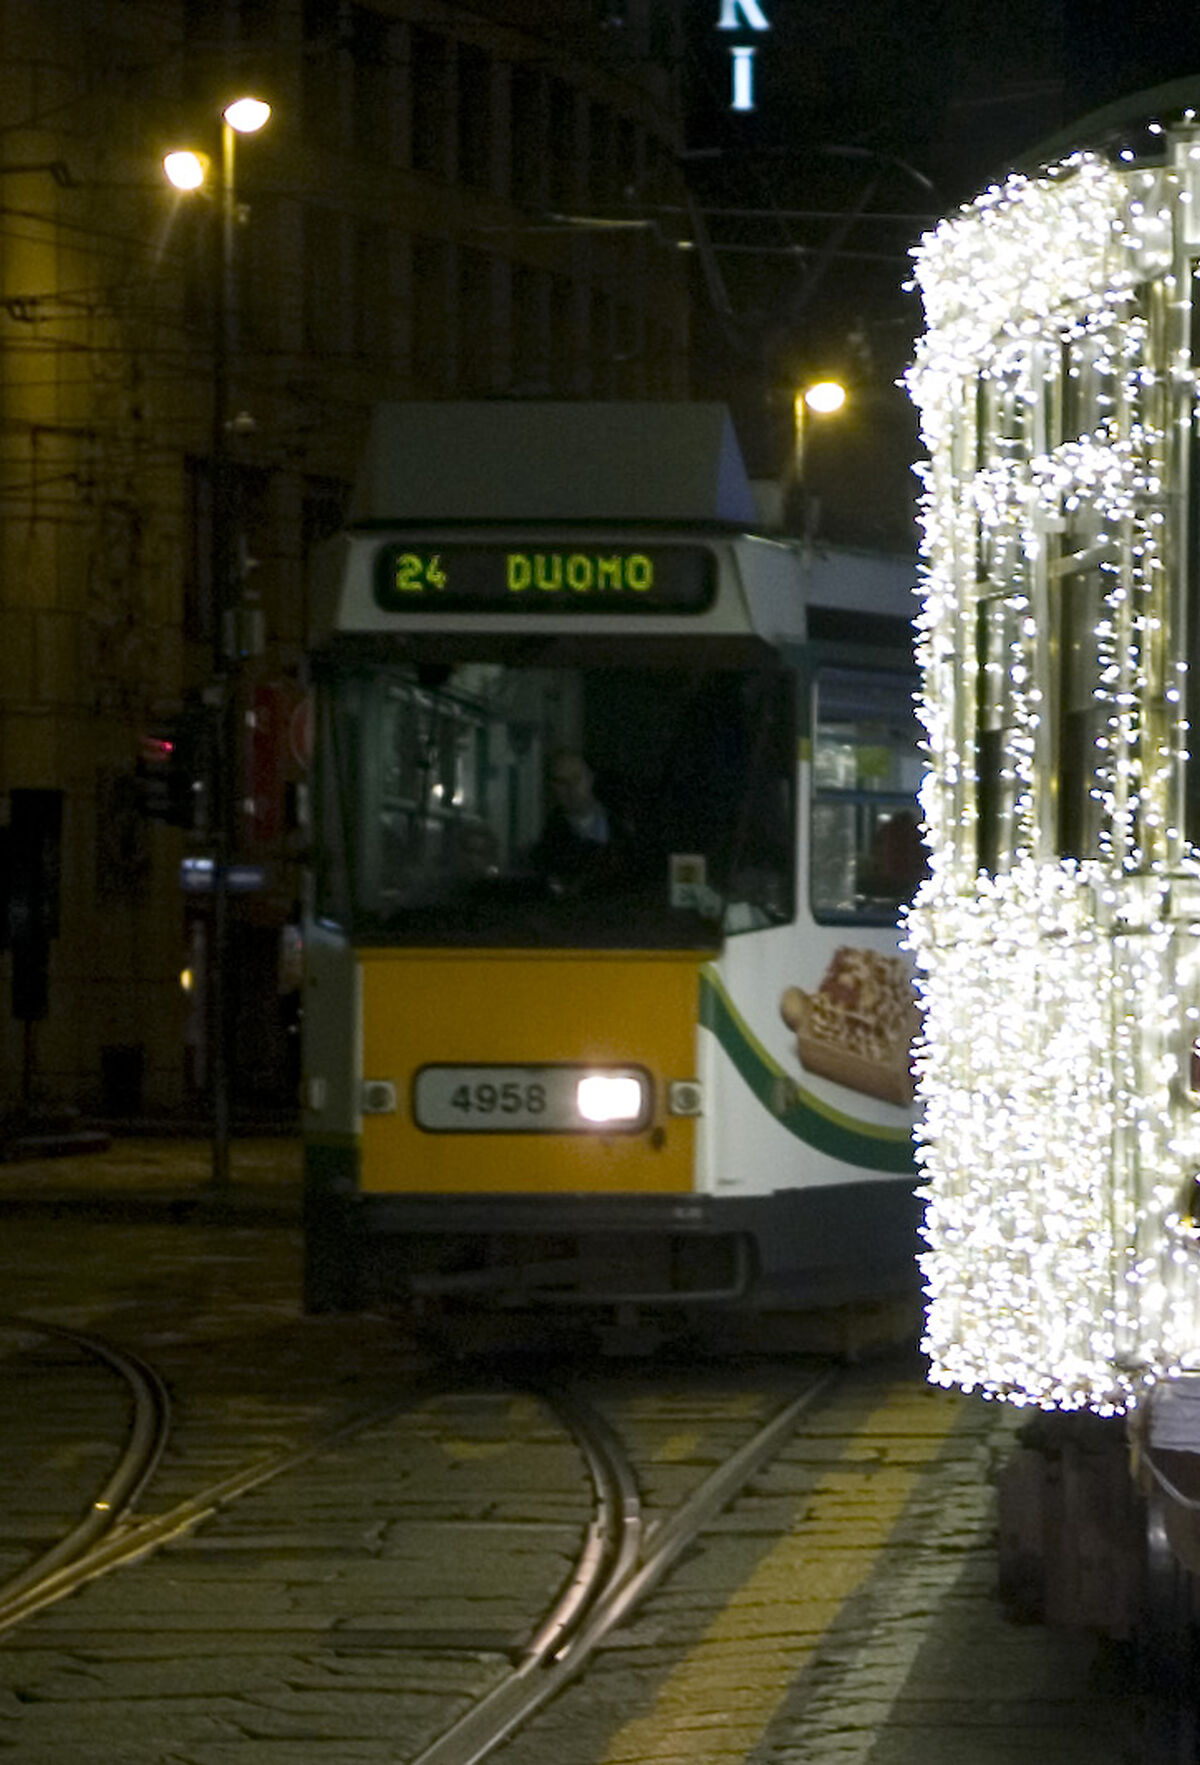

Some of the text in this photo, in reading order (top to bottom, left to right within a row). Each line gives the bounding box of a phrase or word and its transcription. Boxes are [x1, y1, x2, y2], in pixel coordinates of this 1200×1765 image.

[395, 553, 654, 591] 24 DUOMO
[451, 1083, 547, 1114] 4958
